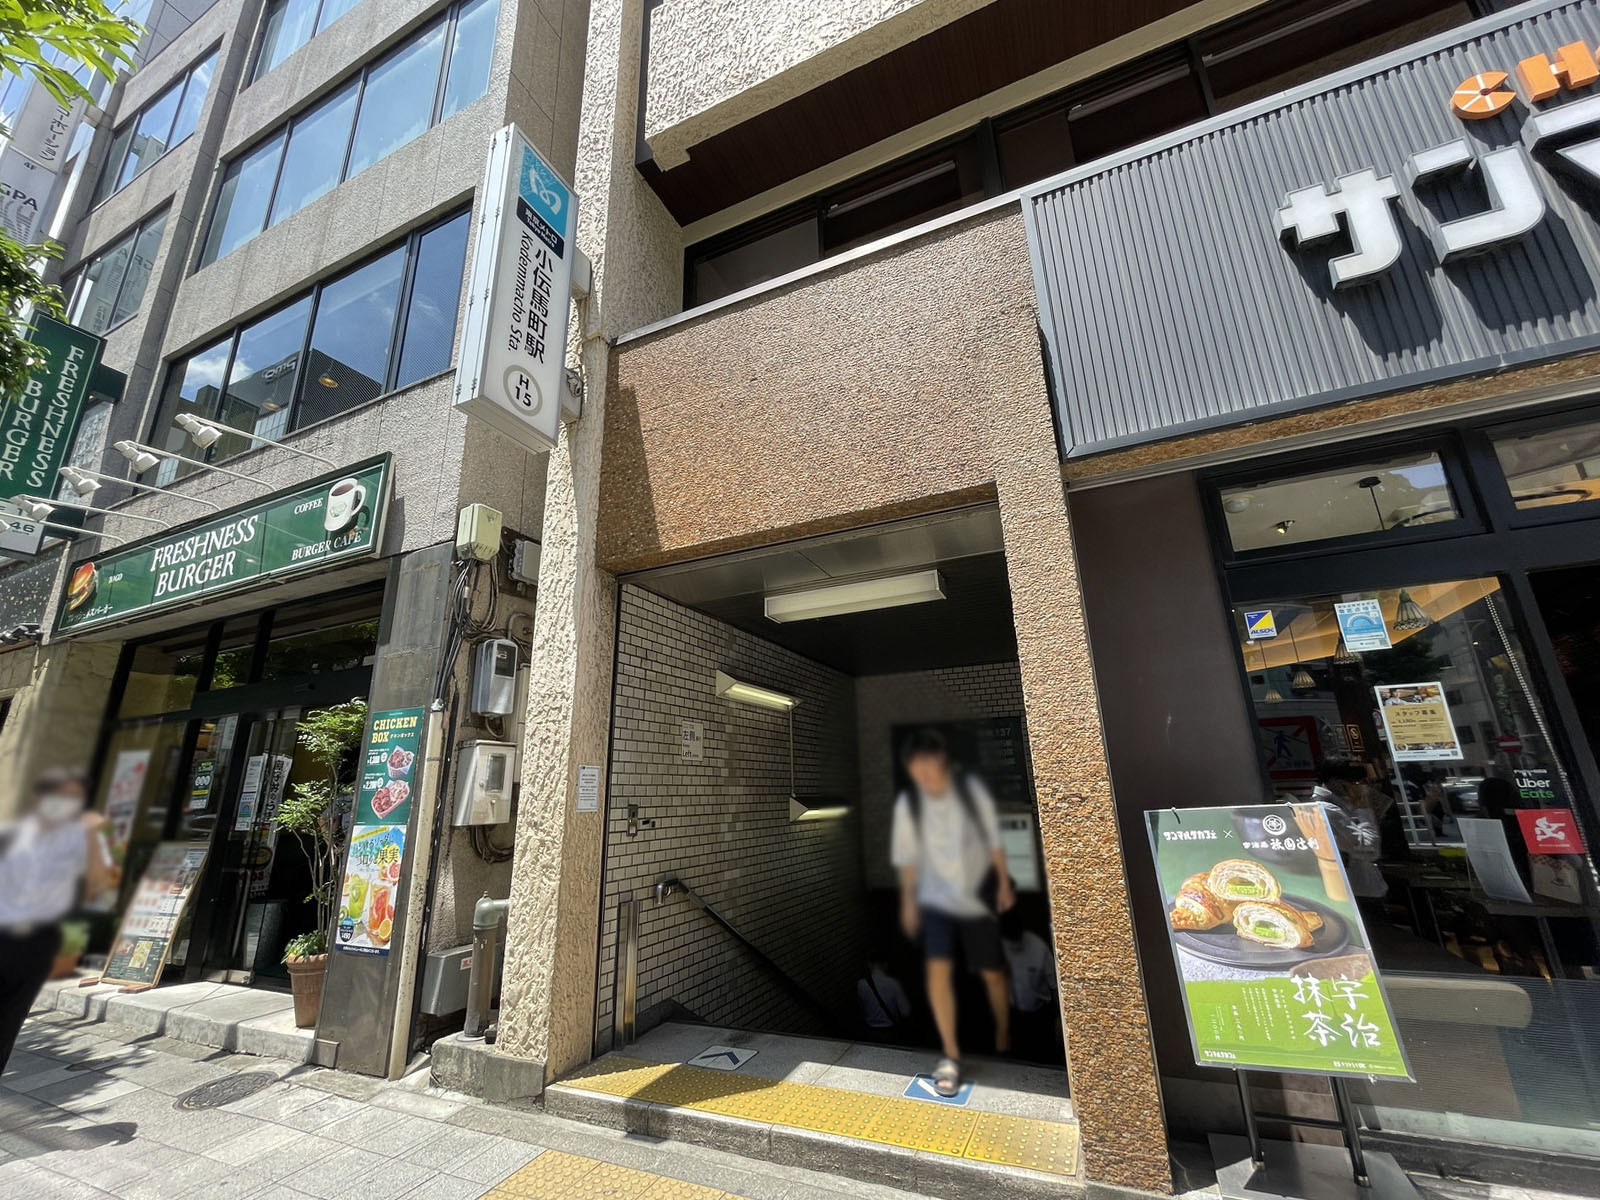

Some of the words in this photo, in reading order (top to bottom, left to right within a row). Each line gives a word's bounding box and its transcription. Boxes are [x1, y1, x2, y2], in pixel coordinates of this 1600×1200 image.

[1450, 40, 1600, 120] CH
[510, 230, 534, 324] Kodemmacho
[524, 248, 554, 364] 小伝馬町駅
[507, 322, 523, 352] Sta.
[514, 384, 532, 407] 15
[518, 374, 530, 389] H
[0, 379, 43, 481] BURGER
[26, 344, 85, 489] FRESHNESS
[294, 497, 324, 515] COFFEE
[150, 515, 258, 573] FRESHNESS
[291, 539, 331, 561] BURGER
[154, 550, 236, 597] BURGER
[373, 716, 418, 731] CHICKEN
[1395, 709, 1437, 717] スタッフ募集
[371, 731, 390, 743] BOX
[1515, 778, 1550, 788] Uber
[1520, 788, 1554, 799] Eats
[1289, 972, 1342, 1047] 抹茶
[1331, 974, 1382, 1049] 宇治
